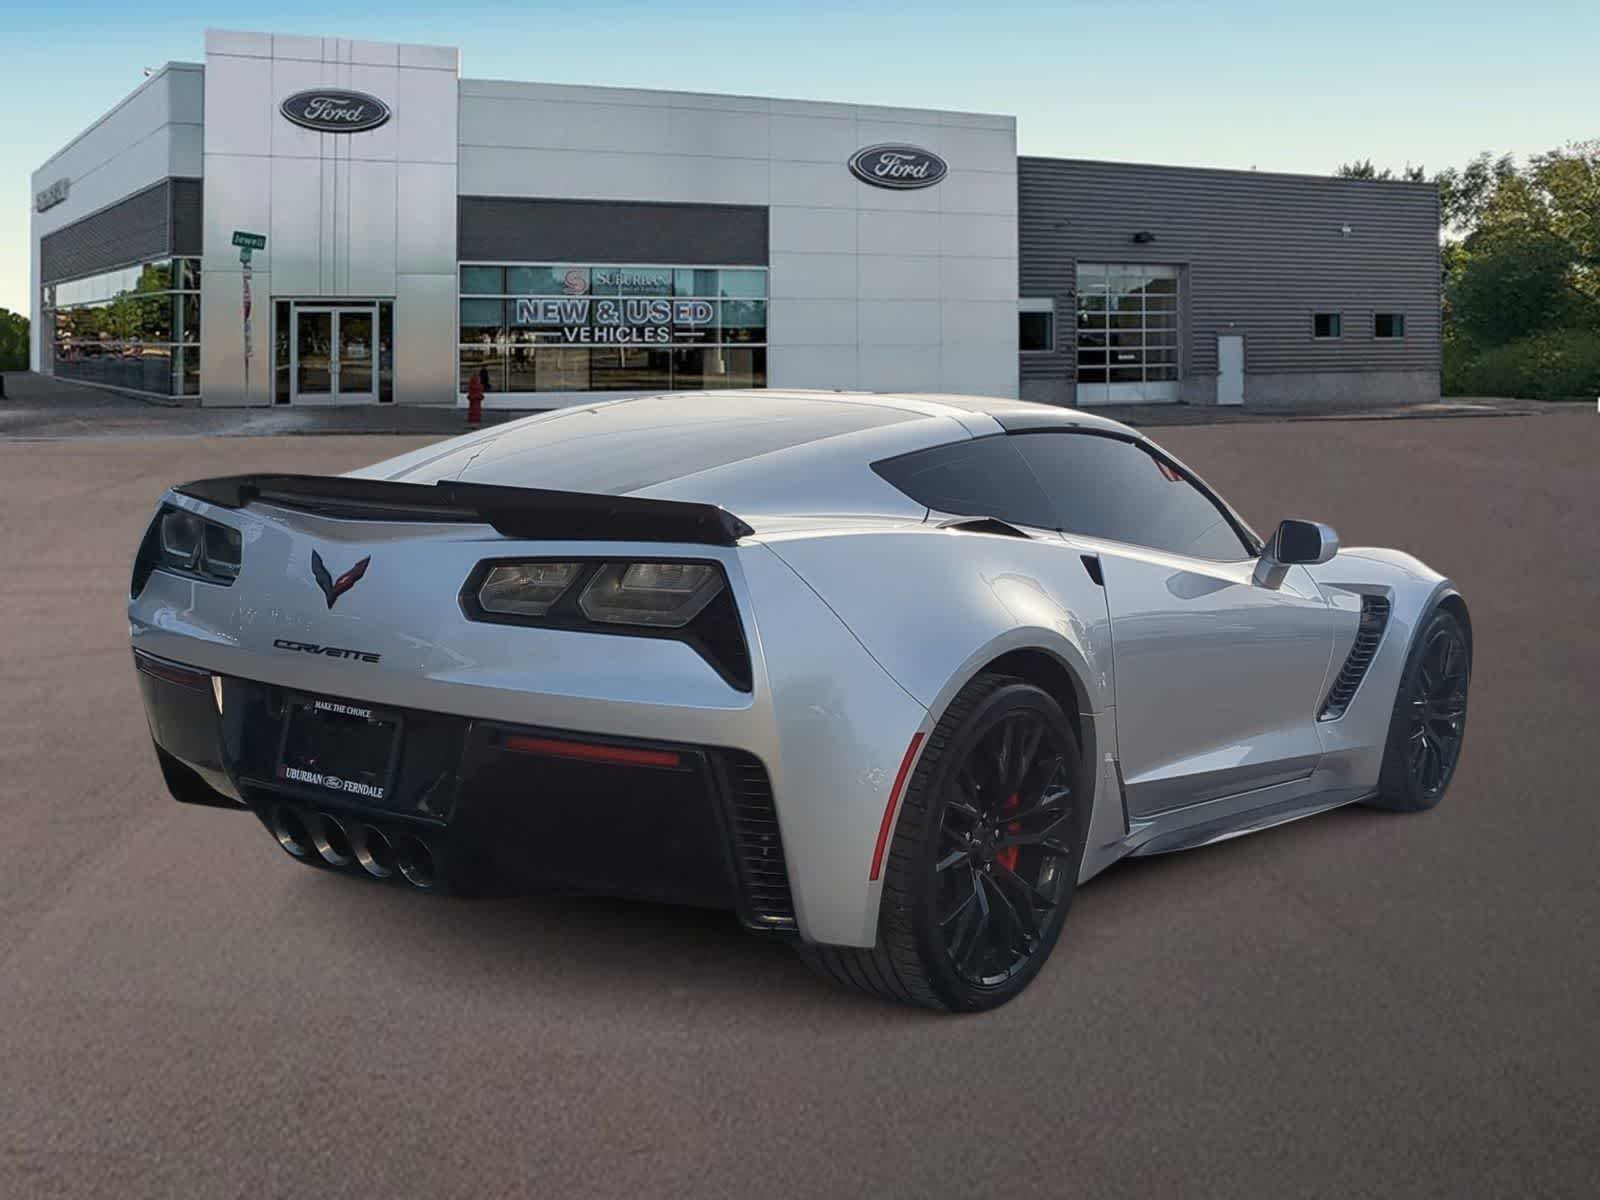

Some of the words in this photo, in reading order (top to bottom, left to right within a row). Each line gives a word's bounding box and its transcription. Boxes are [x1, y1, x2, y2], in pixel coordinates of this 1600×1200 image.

[303, 96, 365, 121] Ford
[873, 151, 930, 178] Ford
[515, 299, 590, 325] NEW
[596, 301, 621, 325] &
[626, 300, 714, 325] USED
[563, 326, 670, 343] VEHICLES
[272, 639, 382, 664] CORVETTE
[314, 700, 333, 711] MAKE
[333, 704, 346, 713] THE
[346, 706, 373, 718] CHOICE
[277, 766, 323, 784] UBURBAN
[343, 780, 385, 799] FERNDALE
